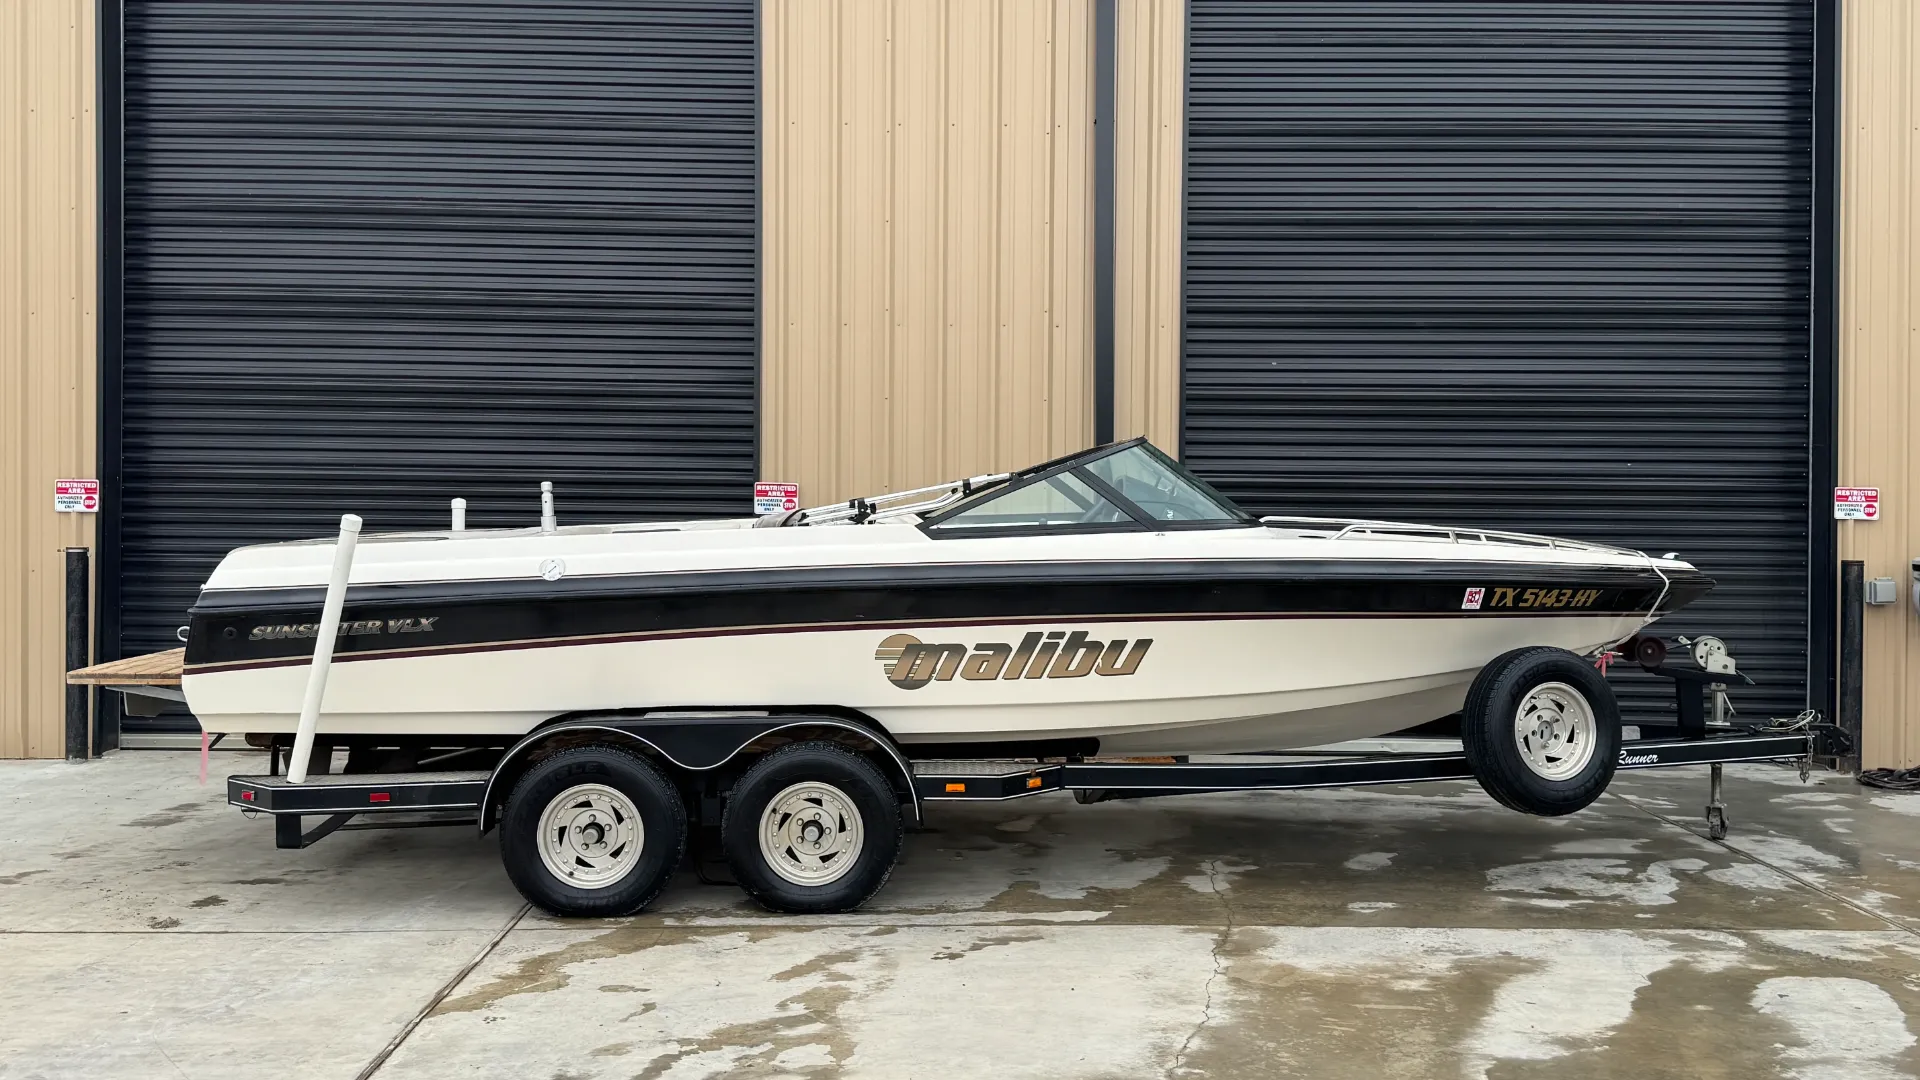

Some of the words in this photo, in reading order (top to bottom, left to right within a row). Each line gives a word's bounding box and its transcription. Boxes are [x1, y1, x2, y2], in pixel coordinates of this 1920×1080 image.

[1490, 588, 1521, 607] TX
[1519, 588, 1604, 607] 5143-HY
[387, 616, 440, 634] VLX
[888, 631, 1154, 681] malibu
